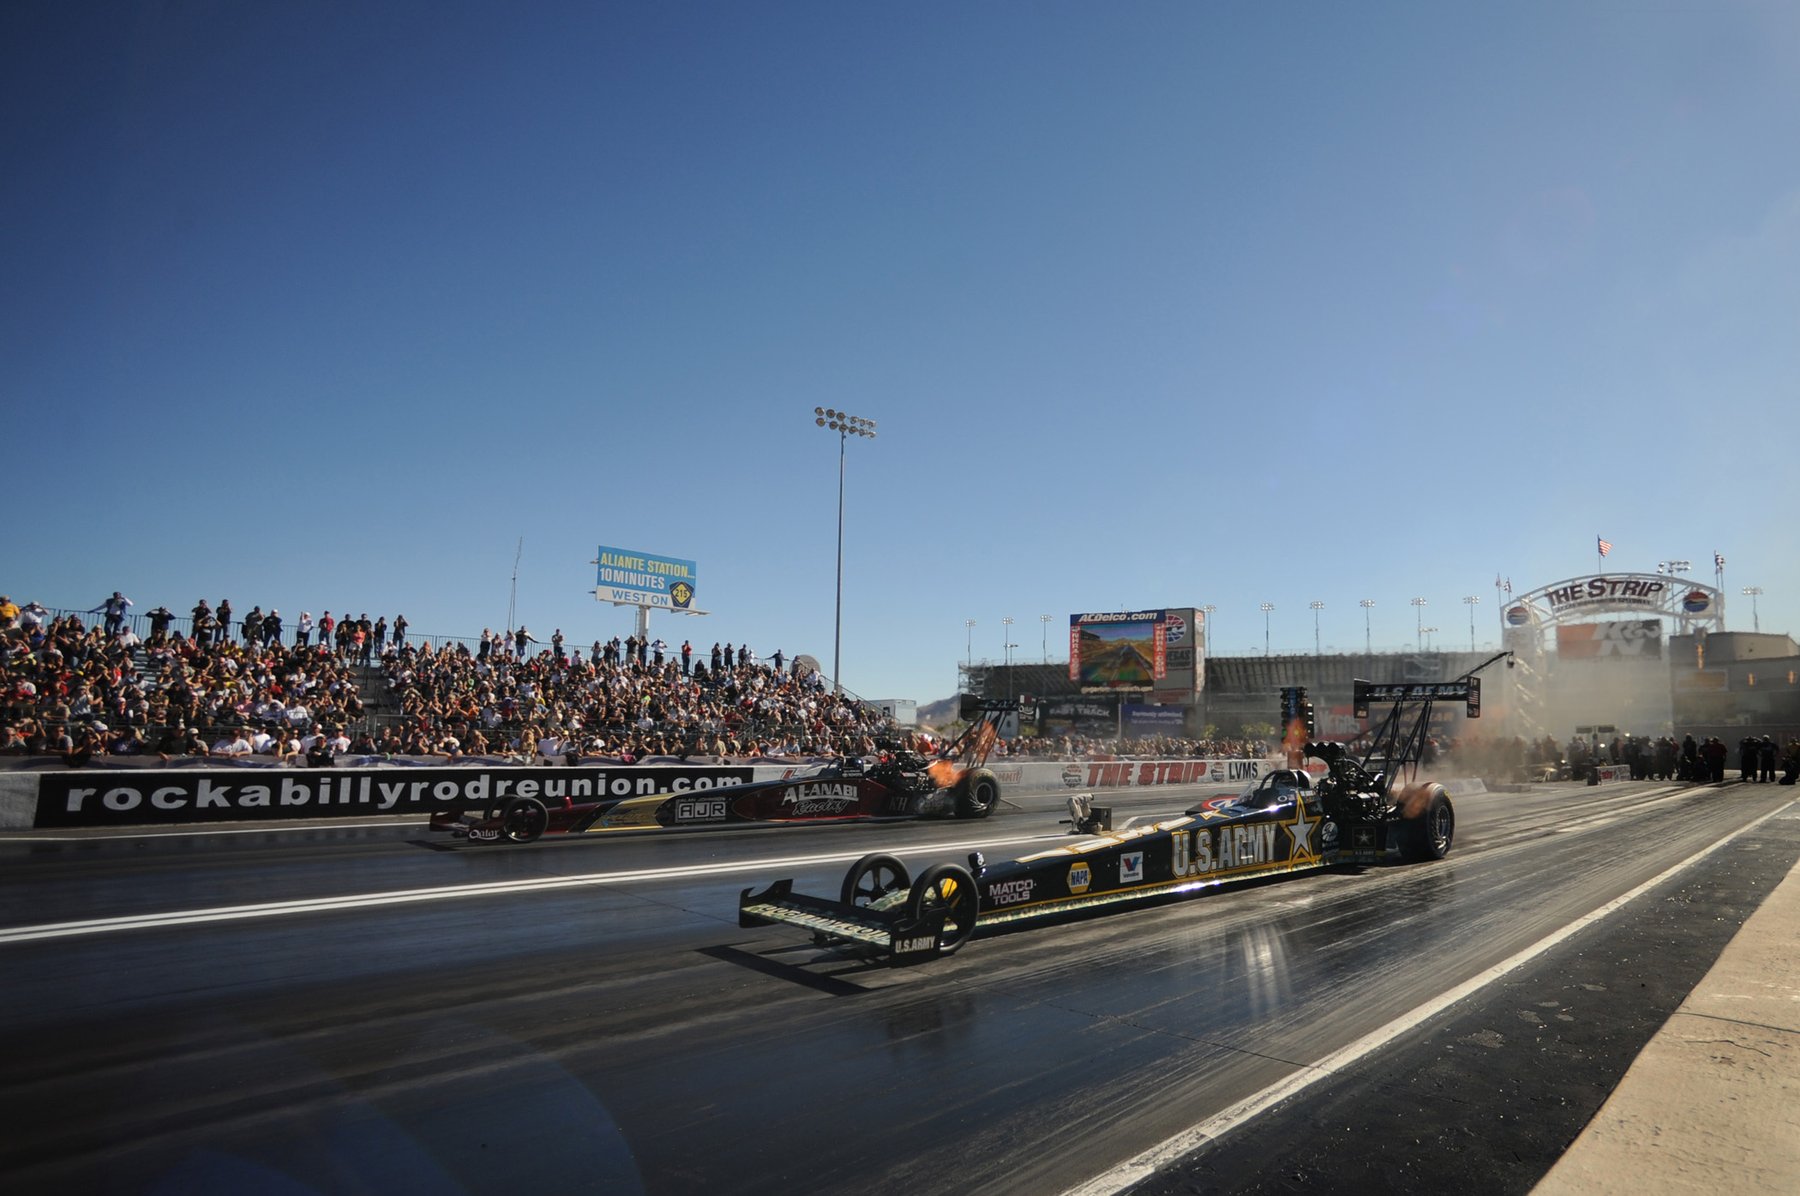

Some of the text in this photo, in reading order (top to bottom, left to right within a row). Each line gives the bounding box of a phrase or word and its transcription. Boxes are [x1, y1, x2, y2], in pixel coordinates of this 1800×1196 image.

[600, 552, 645, 570] ALIANTE
[612, 590, 668, 606] WEST ON
[675, 589, 688, 598] 215
[1544, 584, 1588, 607] THE
[1588, 578, 1664, 598] STRIP
[1079, 612, 1158, 623] ACDelco.com
[1077, 707, 1110, 717] TRACK
[1086, 762, 1135, 787] THE
[1137, 761, 1208, 786] STRIP
[1229, 761, 1259, 780] LVMS
[66, 772, 743, 812] rockabillyrodreunion.com
[680, 802, 726, 818] AJR
[792, 799, 849, 816] Racing
[468, 829, 501, 841] Qatar
[1070, 869, 1089, 886] NAPA
[989, 879, 1034, 897] MATCO
[993, 890, 1031, 905] TOOLS
